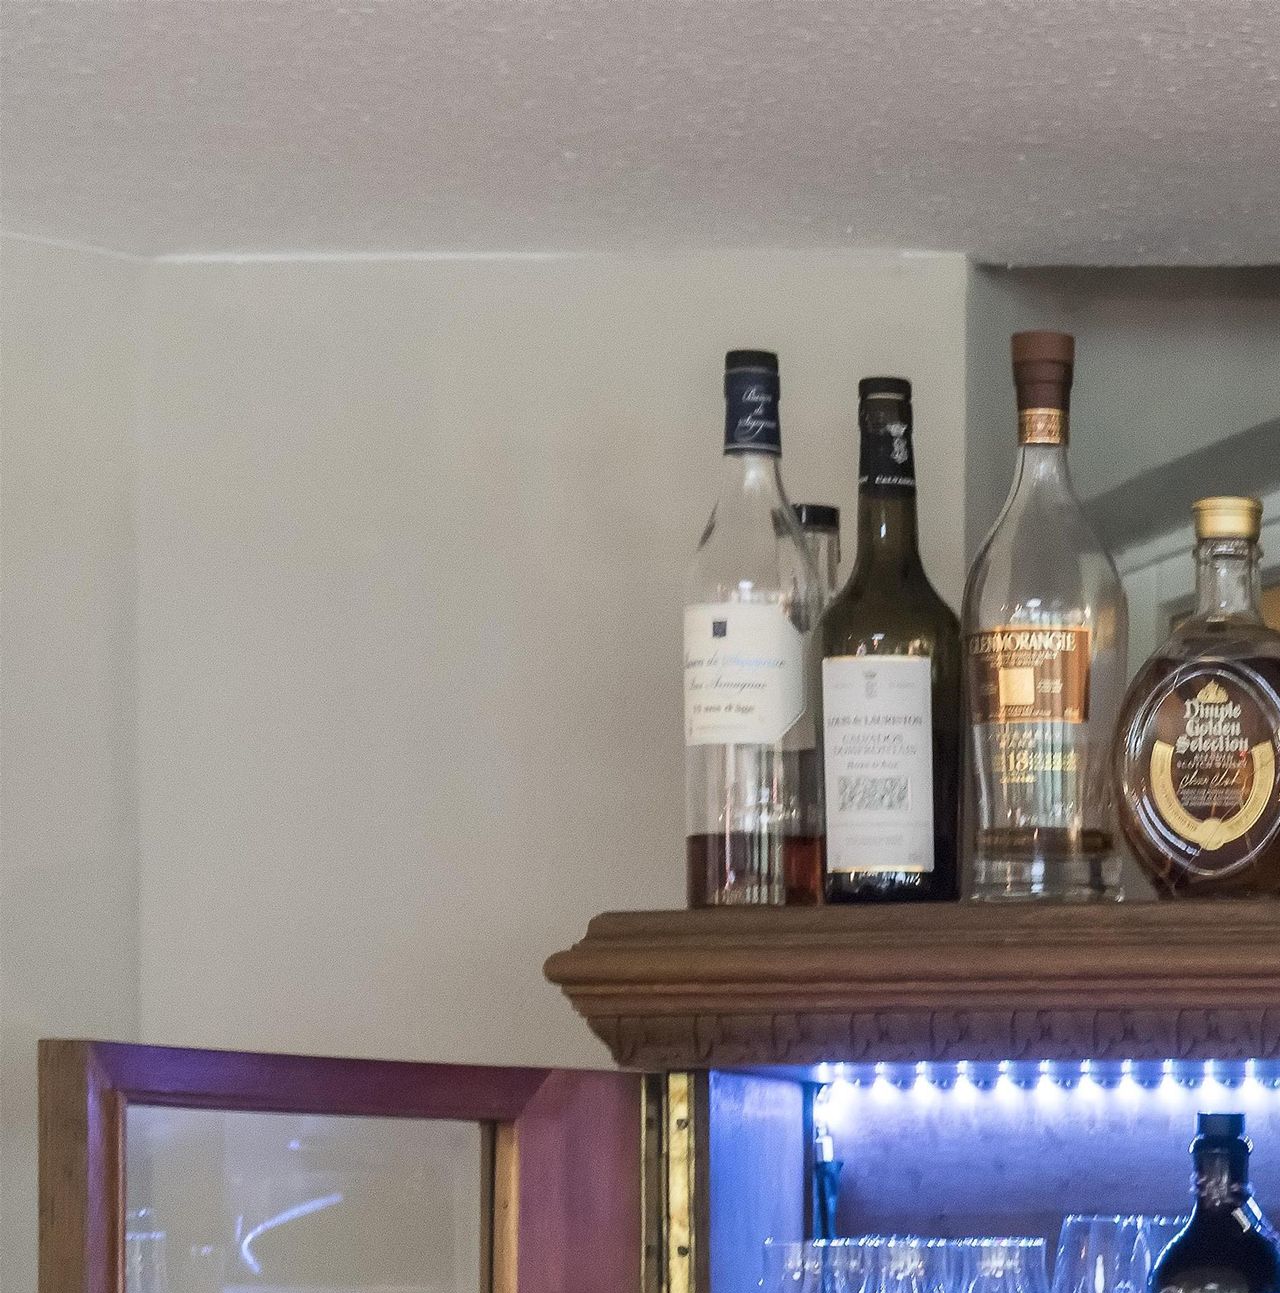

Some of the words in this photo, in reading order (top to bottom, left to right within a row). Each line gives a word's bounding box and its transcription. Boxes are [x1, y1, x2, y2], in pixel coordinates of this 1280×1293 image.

[1183, 699, 1242, 721] Dimple
[1186, 718, 1242, 738] Golden
[1176, 735, 1249, 755] Selection
